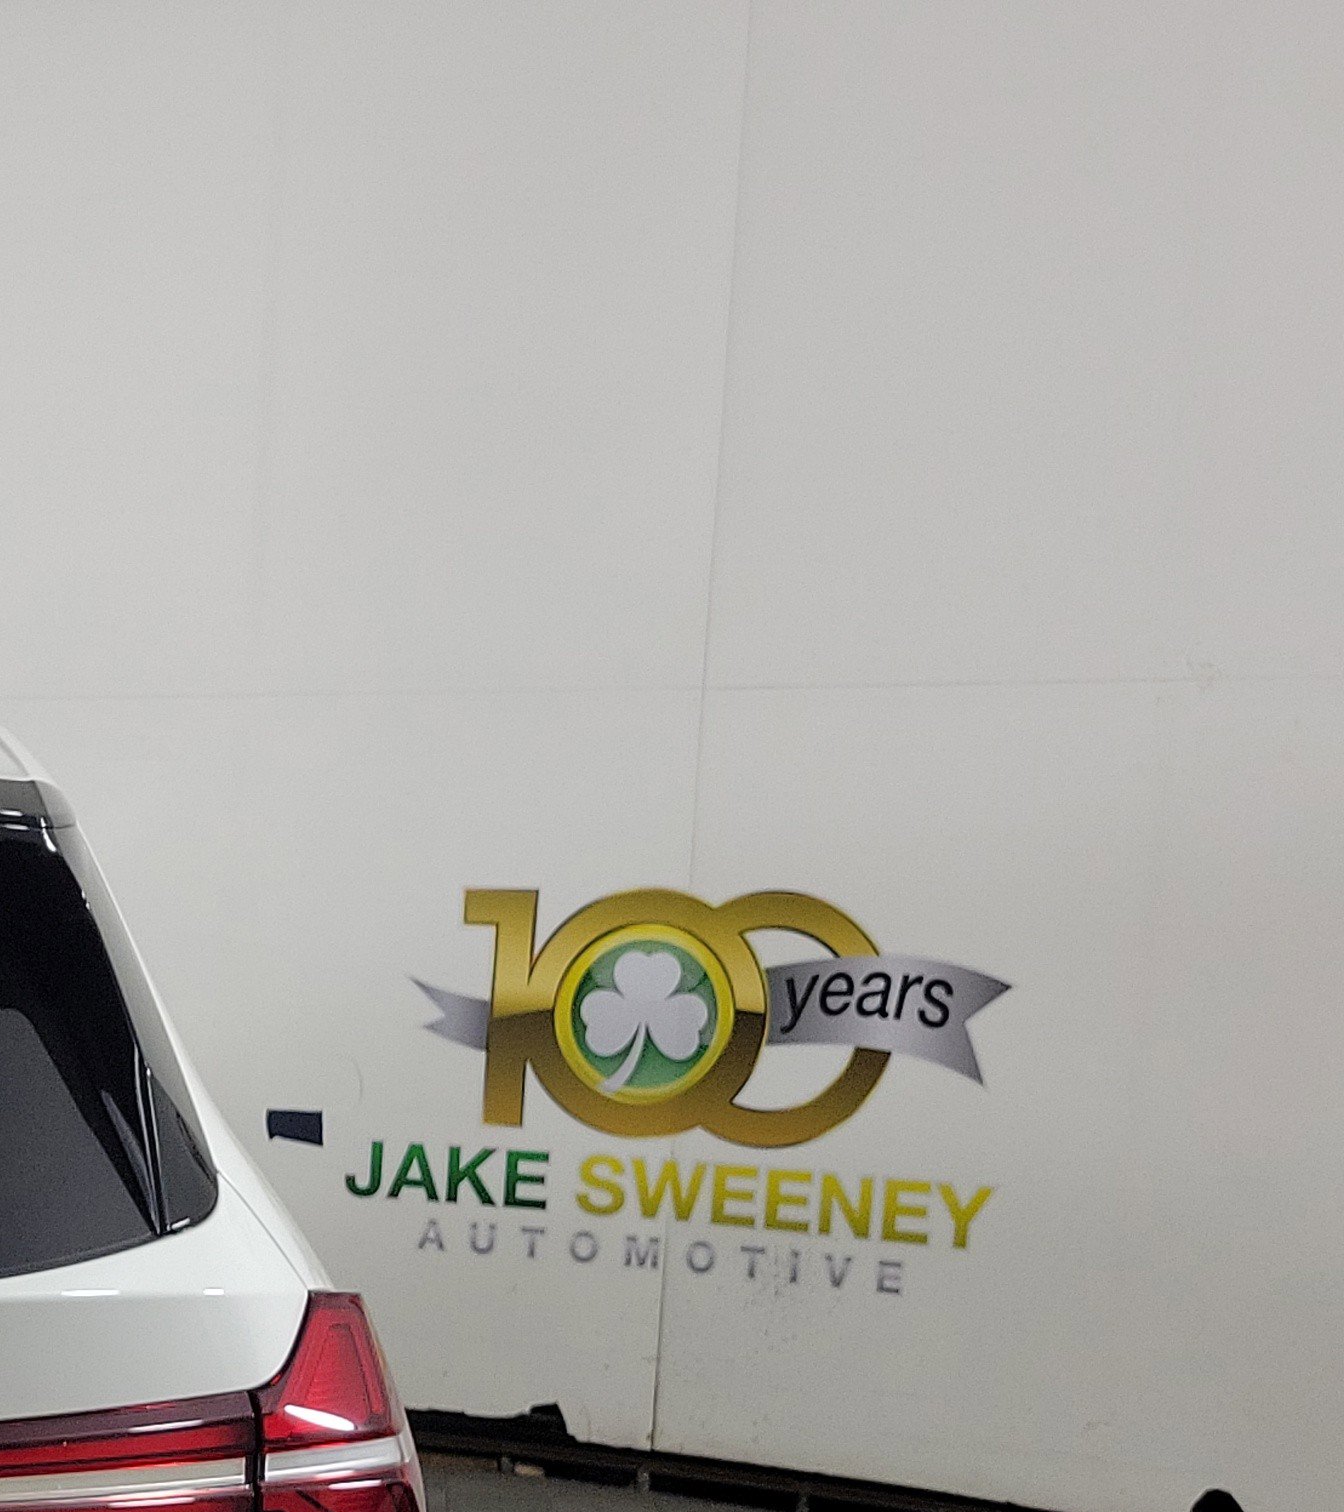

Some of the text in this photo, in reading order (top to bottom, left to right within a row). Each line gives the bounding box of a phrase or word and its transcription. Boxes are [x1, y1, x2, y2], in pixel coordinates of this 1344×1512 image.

[462, 887, 956, 1150] 100 years
[344, 1140, 996, 1250] JAKE SWEENEY
[417, 1216, 906, 1296] AUTOMOTIVE
